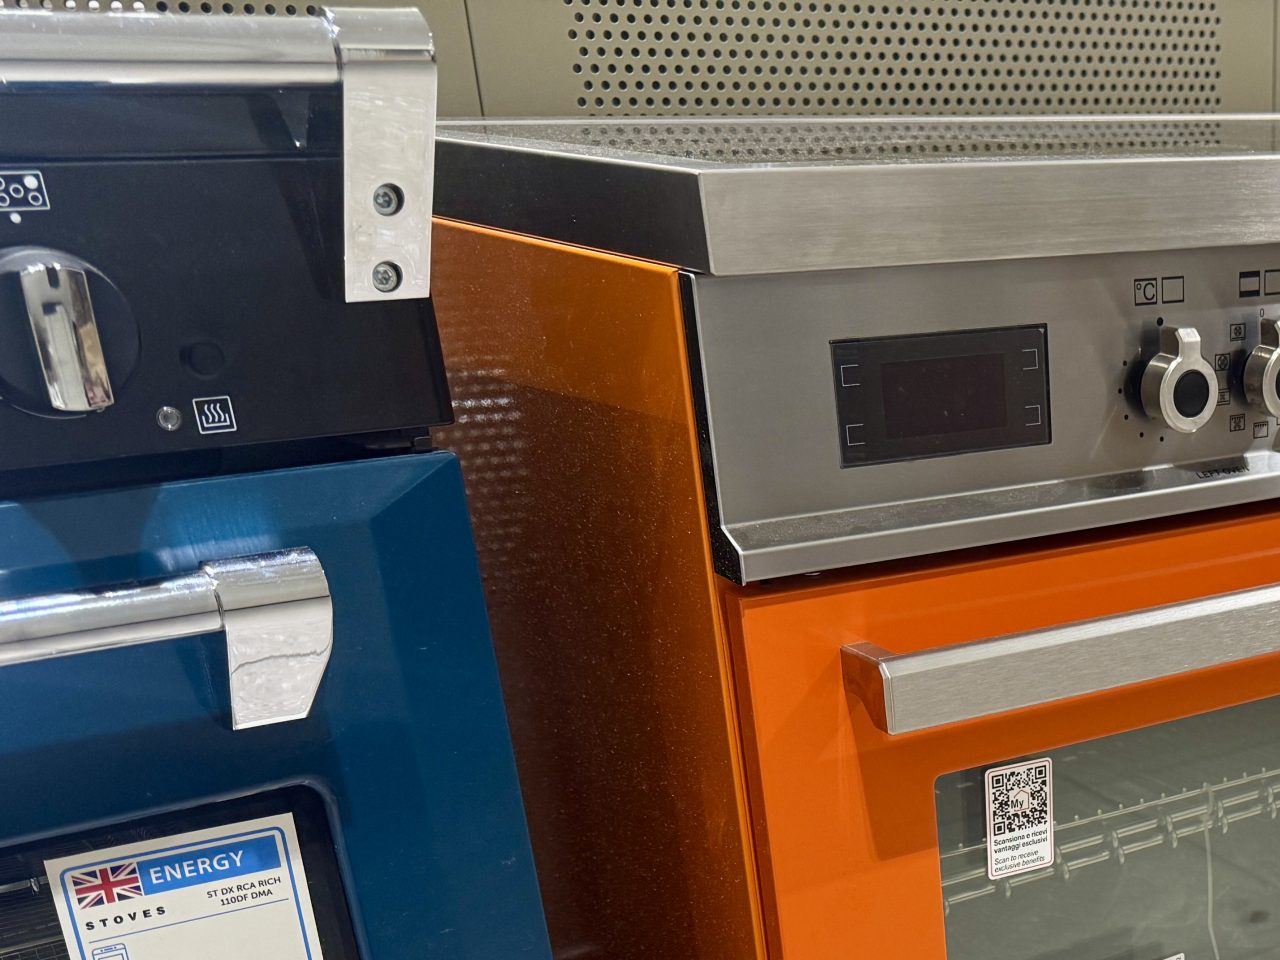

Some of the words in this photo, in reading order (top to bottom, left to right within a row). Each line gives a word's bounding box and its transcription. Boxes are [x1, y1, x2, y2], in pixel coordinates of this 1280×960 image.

[1010, 799, 1024, 809] My
[150, 850, 244, 885] ENERGY
[995, 857, 1010, 865] Scan
[206, 890, 219, 898] ST
[221, 886, 234, 895] DX
[236, 882, 256, 892] RCA
[258, 876, 281, 887] RICH
[221, 894, 248, 906] 110DF
[251, 888, 273, 899] DMA
[86, 906, 166, 931] STOVES
